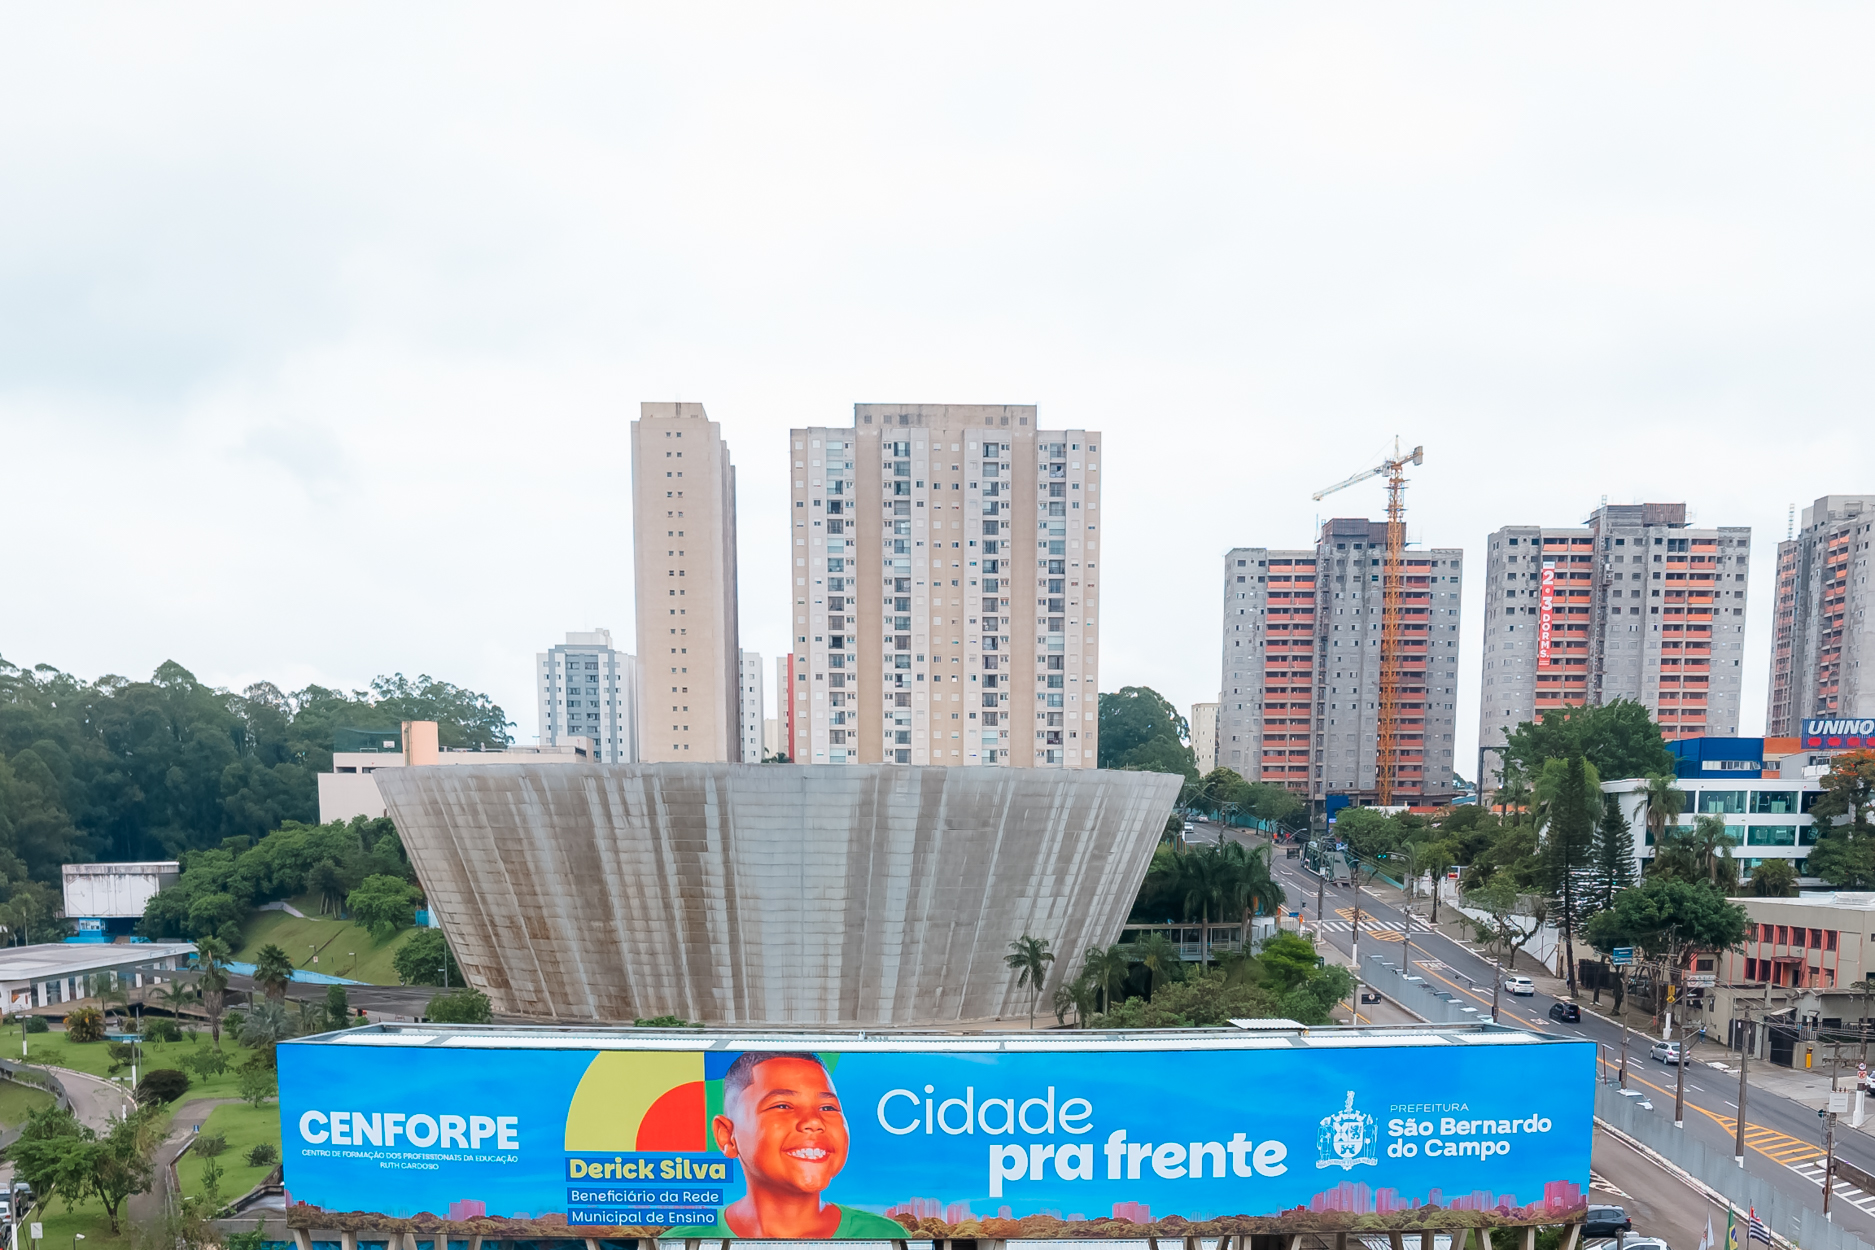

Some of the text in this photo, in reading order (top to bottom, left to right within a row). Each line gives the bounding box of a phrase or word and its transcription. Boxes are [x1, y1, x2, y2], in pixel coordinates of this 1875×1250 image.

[1542, 570, 1554, 585] 2
[1541, 596, 1553, 611] 3
[1540, 613, 1551, 658] DORMS.
[1808, 720, 1875, 735] UNINO
[877, 1084, 1094, 1136] Cidade
[1390, 1103, 1470, 1113] PREFEITURA
[299, 1110, 520, 1150] CENFORPE
[1387, 1113, 1553, 1137] São Bernardo
[302, 1149, 331, 1157] CENTRO
[332, 1150, 341, 1158] DE
[386, 1152, 402, 1160] DOS
[463, 1154, 474, 1162] DA
[1387, 1138, 1511, 1161] do Campo
[401, 1162, 439, 1170] CARDOSO
[569, 1157, 726, 1180] Derick Silva
[988, 1129, 1289, 1198] pra frente
[571, 1190, 719, 1203] Beneficiário da Rede
[572, 1210, 715, 1226] Municipal de Ensino
